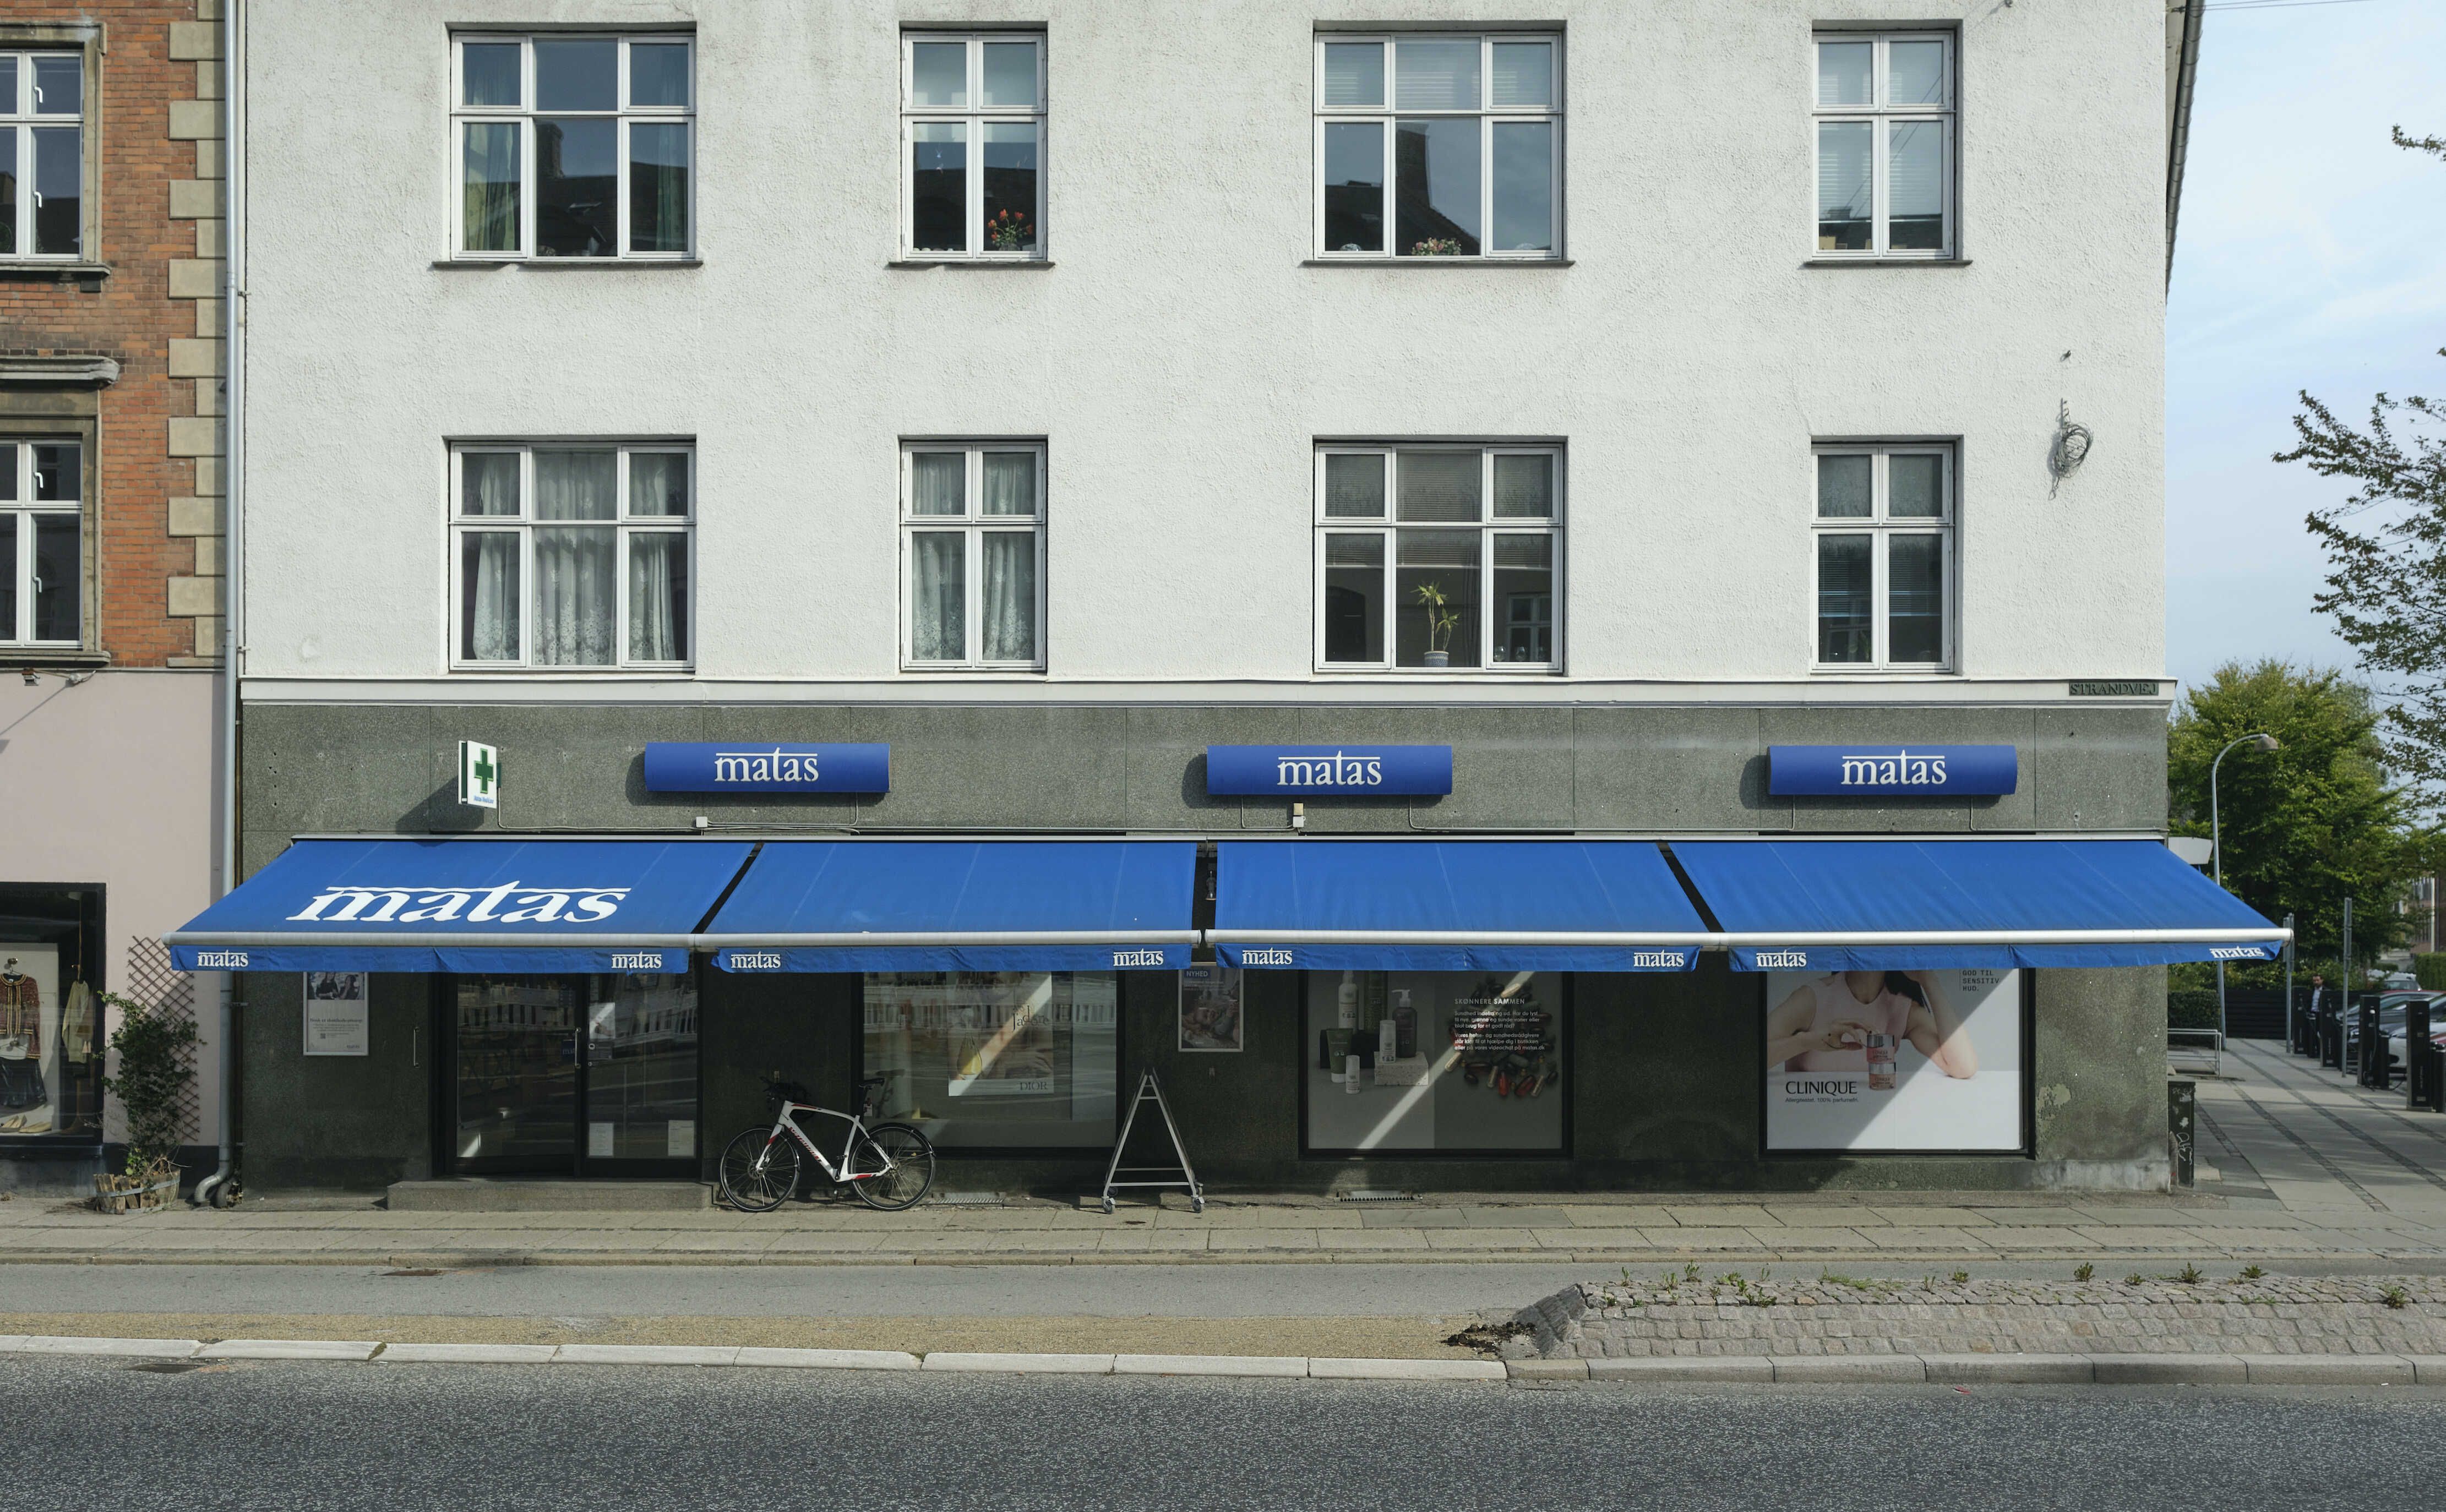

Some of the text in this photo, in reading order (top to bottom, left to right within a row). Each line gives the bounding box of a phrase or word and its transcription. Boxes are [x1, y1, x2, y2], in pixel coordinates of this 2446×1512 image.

[2070, 683, 2157, 695] STRANDVEJ
[715, 747, 819, 782] matas
[1277, 750, 1382, 785] matas
[1842, 750, 1947, 784] matas
[286, 881, 631, 923] matas
[198, 950, 248, 967] matas
[612, 951, 662, 969] matas
[731, 951, 781, 969] matas
[1113, 948, 1164, 967] matas
[1242, 947, 1293, 965] matas
[1633, 949, 1684, 967] matas
[1756, 949, 1807, 967] matas
[2209, 946, 2265, 958] matas
[1020, 1082, 1048, 1090] DIOR
[1786, 1081, 1857, 1096] CLINIQUE
